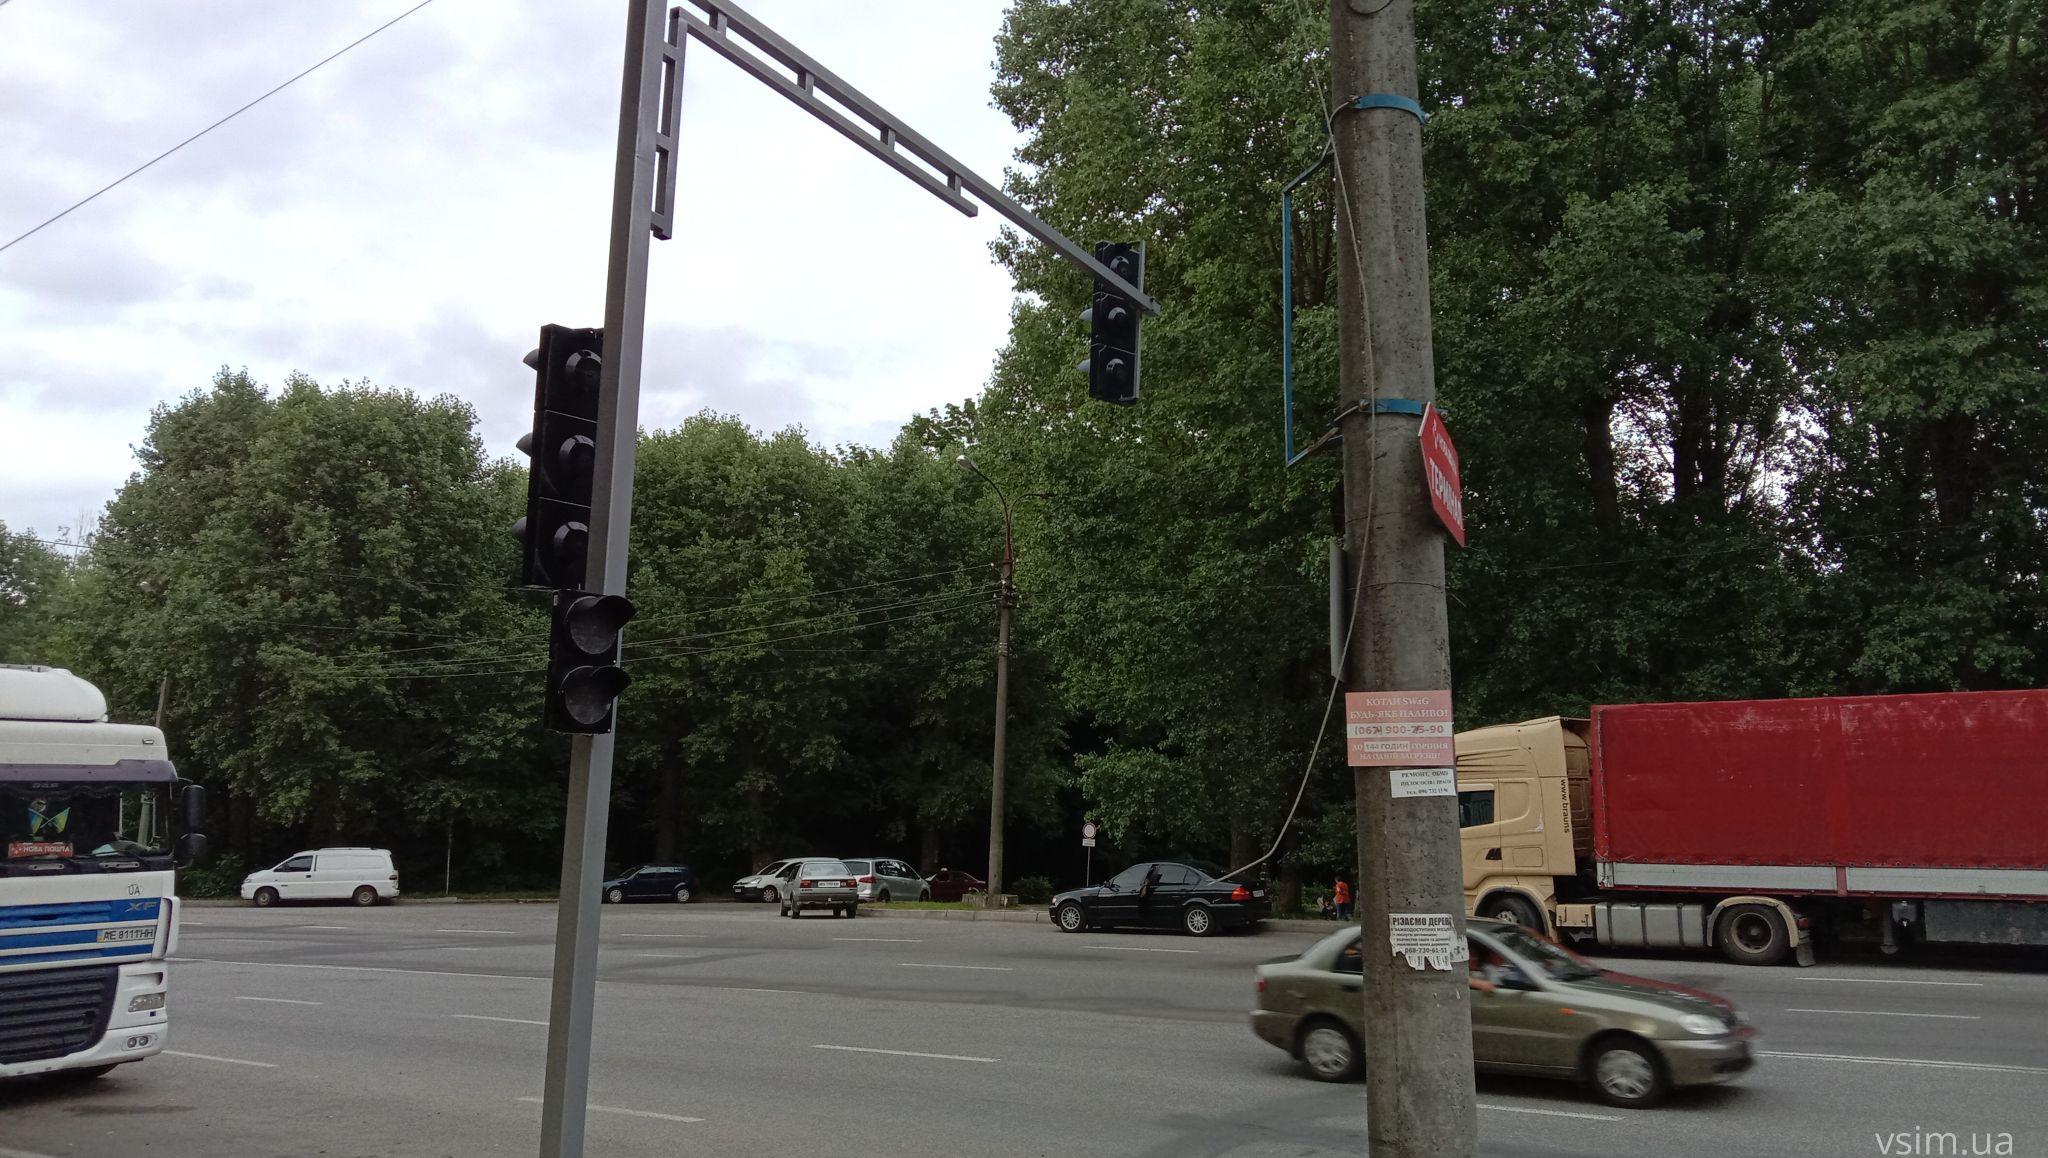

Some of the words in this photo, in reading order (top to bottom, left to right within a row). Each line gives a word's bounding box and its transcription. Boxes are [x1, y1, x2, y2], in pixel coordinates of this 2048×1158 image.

[1380, 743, 1409, 751] ГОДИН
[23, 845, 43, 853] НОВА
[44, 845, 70, 853] ПОШТА
[128, 884, 141, 895] UA
[125, 902, 157, 912] XF
[1392, 917, 1426, 926] РІЗАЄМО
